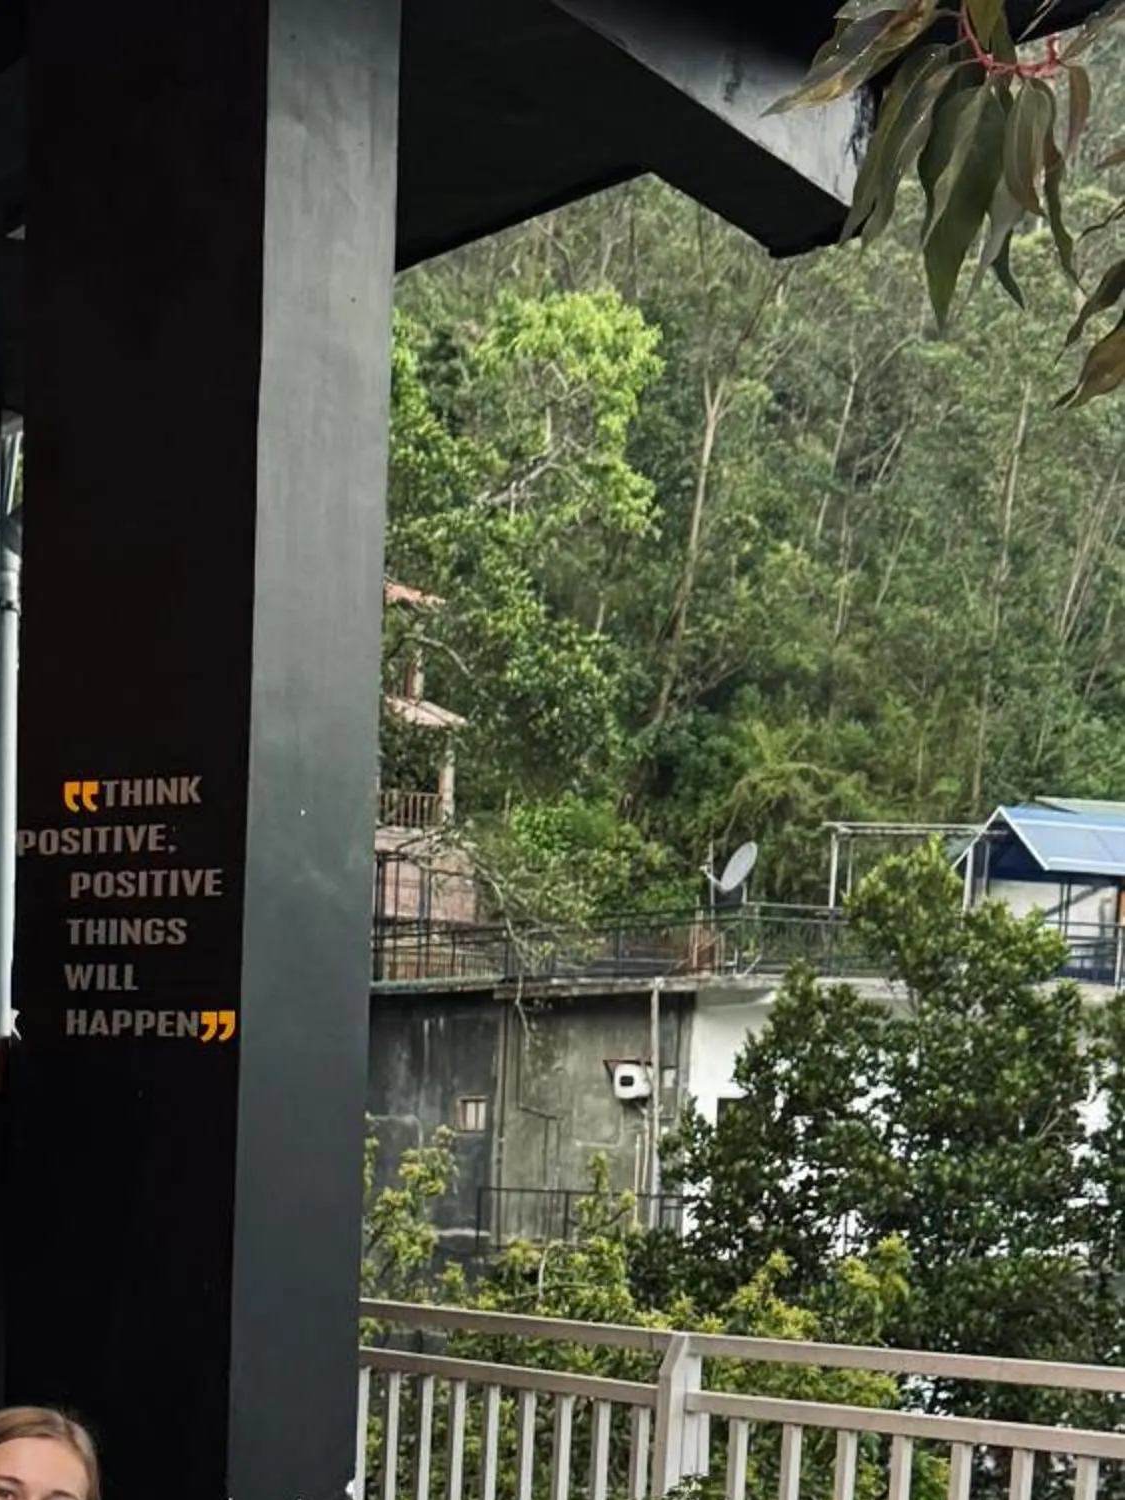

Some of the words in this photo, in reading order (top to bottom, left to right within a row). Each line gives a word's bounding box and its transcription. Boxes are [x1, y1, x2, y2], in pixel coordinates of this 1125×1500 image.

[70, 869, 223, 898] POSITIVE
[66, 918, 187, 945] THINGS
[64, 964, 139, 991] WILL
